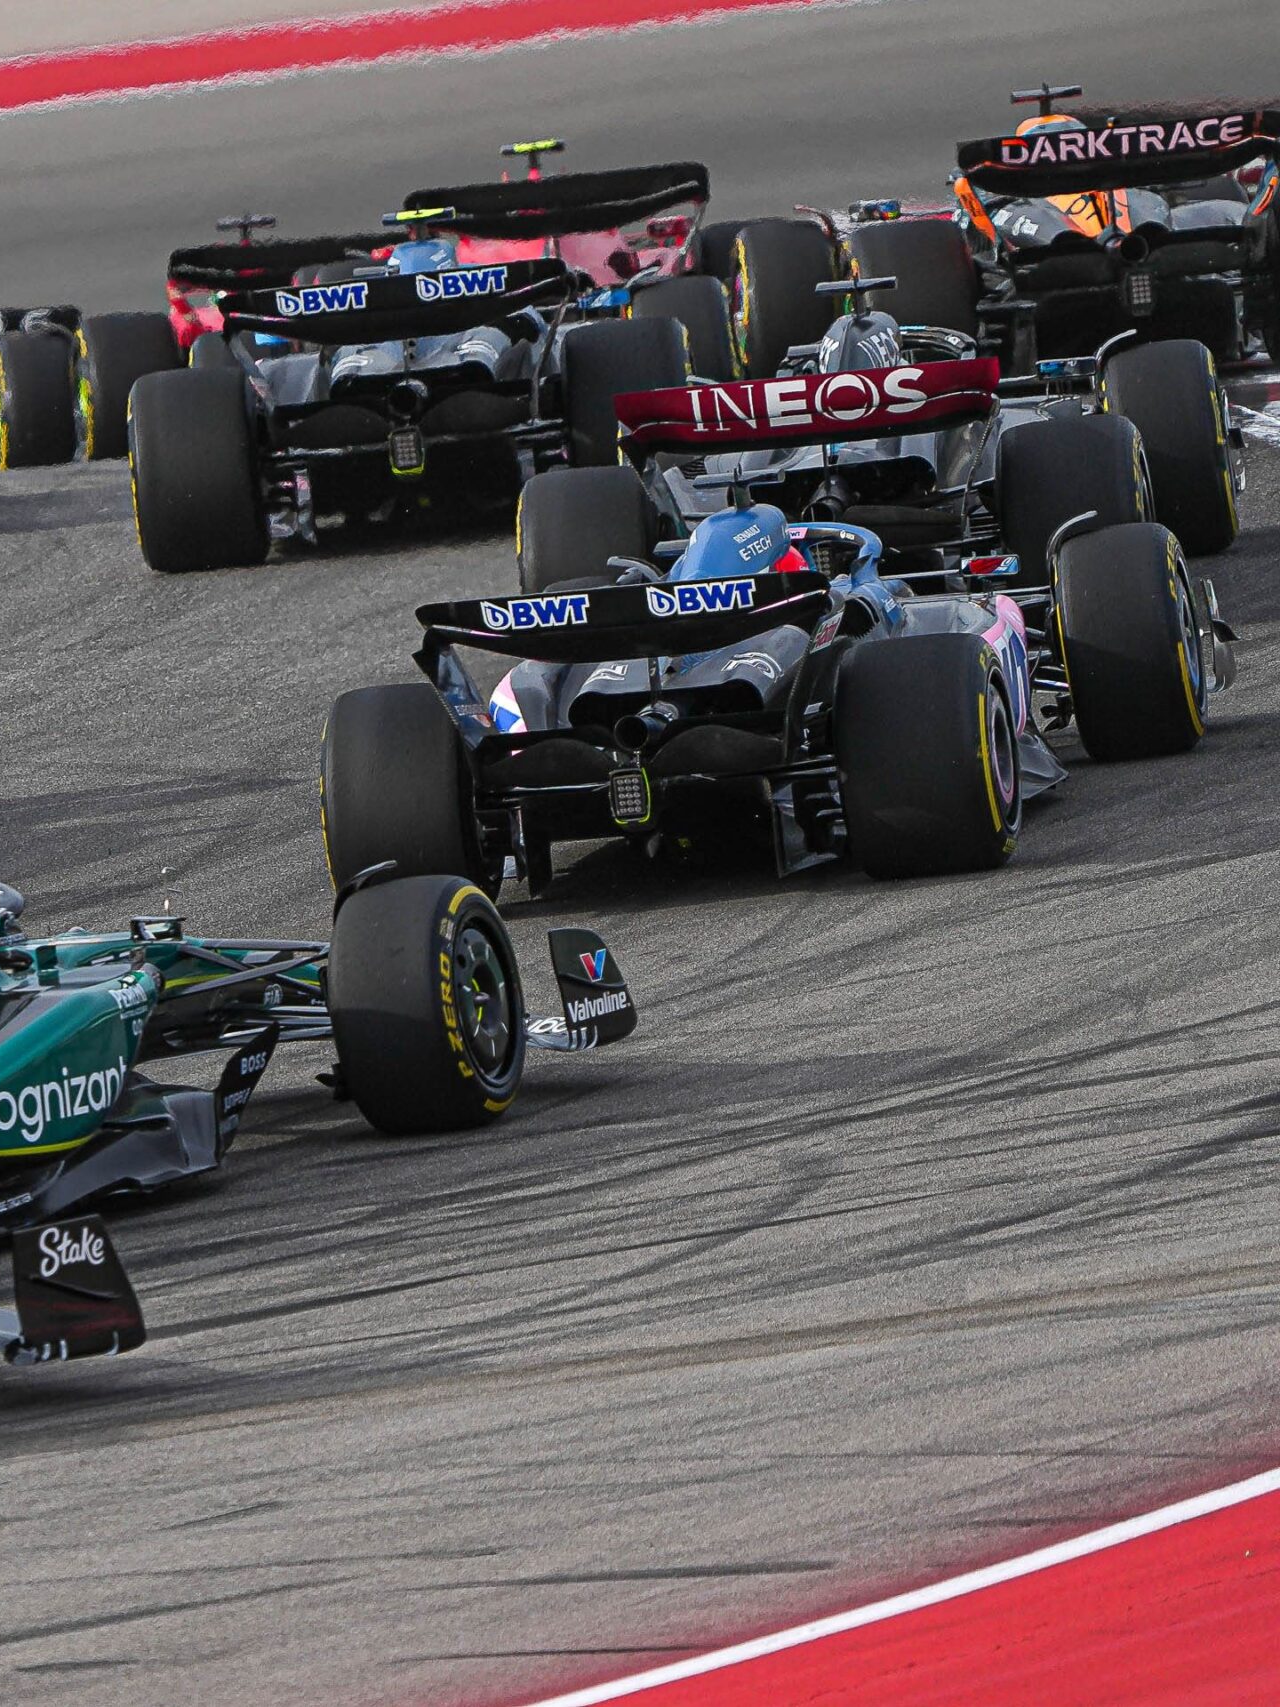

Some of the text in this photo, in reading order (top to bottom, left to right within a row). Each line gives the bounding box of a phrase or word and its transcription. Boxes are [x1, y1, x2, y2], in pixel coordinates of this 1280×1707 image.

[1001, 115, 1244, 166] DARKTRACE
[300, 282, 369, 314] BWT
[440, 266, 508, 299] BWT
[688, 367, 927, 433] INEOS
[732, 524, 761, 543] RENAULT
[738, 535, 773, 562] E-TECH
[508, 594, 590, 630] BWT
[674, 578, 756, 615] BWT
[241, 1051, 267, 1075] BOSS
[39, 1226, 105, 1278] Stake
